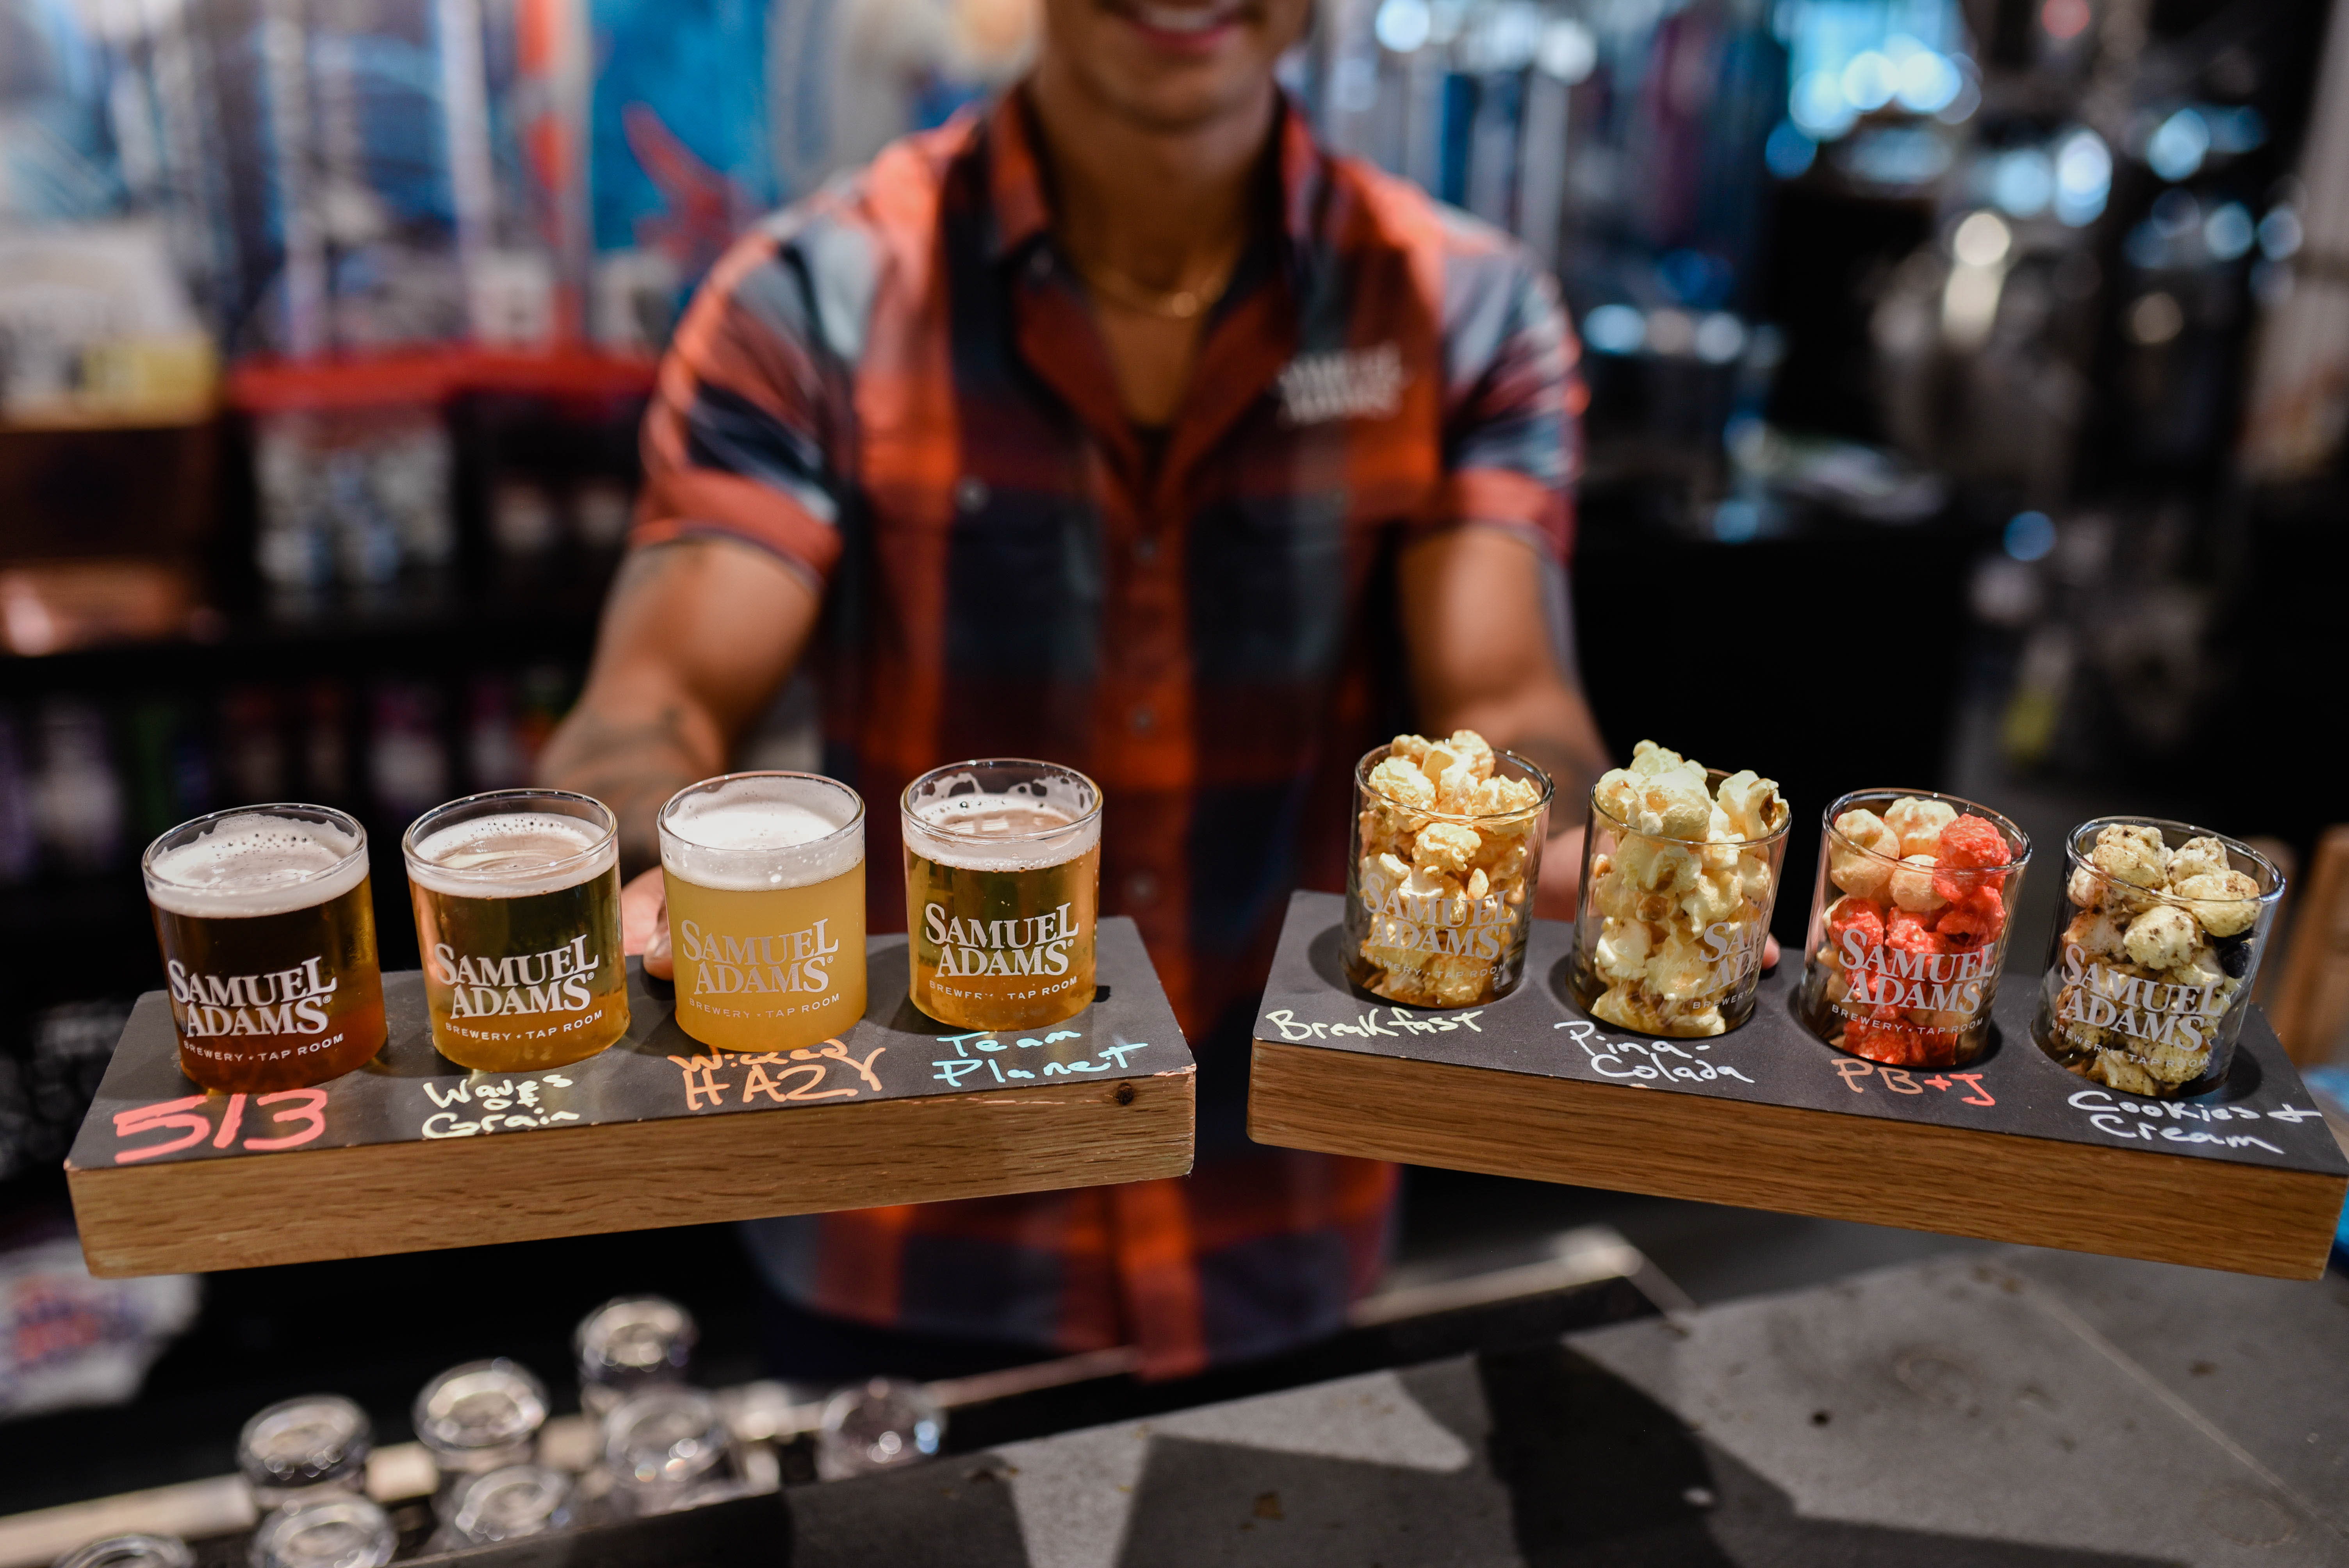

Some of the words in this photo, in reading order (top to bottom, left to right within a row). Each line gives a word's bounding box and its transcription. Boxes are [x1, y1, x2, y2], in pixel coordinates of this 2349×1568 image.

[1363, 873, 1513, 928] SAMUEL
[681, 918, 839, 966] SAMUEL
[925, 902, 1079, 949] SAMUEL
[434, 934, 599, 987] SAMUEL
[1360, 948, 1422, 976] BREWERY
[1470, 964, 1505, 977] ROOM
[1838, 928, 1996, 983] SAMUEL
[166, 956, 337, 1008] SAMUEL
[1007, 991, 1036, 1000] TAP
[1042, 976, 1078, 996] ROOM
[2061, 944, 2225, 1016] SAMUEL
[689, 998, 750, 1019] BREWERY
[765, 1008, 795, 1018] TAP
[802, 993, 840, 1013] ROOM
[1832, 1004, 1903, 1033] BREWERY
[1918, 1026, 1945, 1035] TAP
[1952, 1016, 1984, 1034] ROOM
[445, 1023, 512, 1041] BREWERY
[525, 1027, 557, 1040] TAP
[563, 1009, 602, 1033] ROOM
[1265, 1007, 1483, 1041] Breakfast
[184, 1040, 244, 1062] BREWERY
[257, 1049, 291, 1061] TAP
[297, 1033, 344, 1055] ROOM
[937, 1031, 1081, 1057] Team
[2051, 1019, 2114, 1055] BREWERY
[2129, 1054, 2159, 1066] TAP
[2166, 1058, 2209, 1068] ROOM
[1591, 1053, 1756, 1083] Colada
[422, 1107, 580, 1139] Grain
[2067, 1090, 2260, 1122] Cookies
[113, 1088, 327, 1164] 513
[2090, 1114, 2285, 1154] Cream
